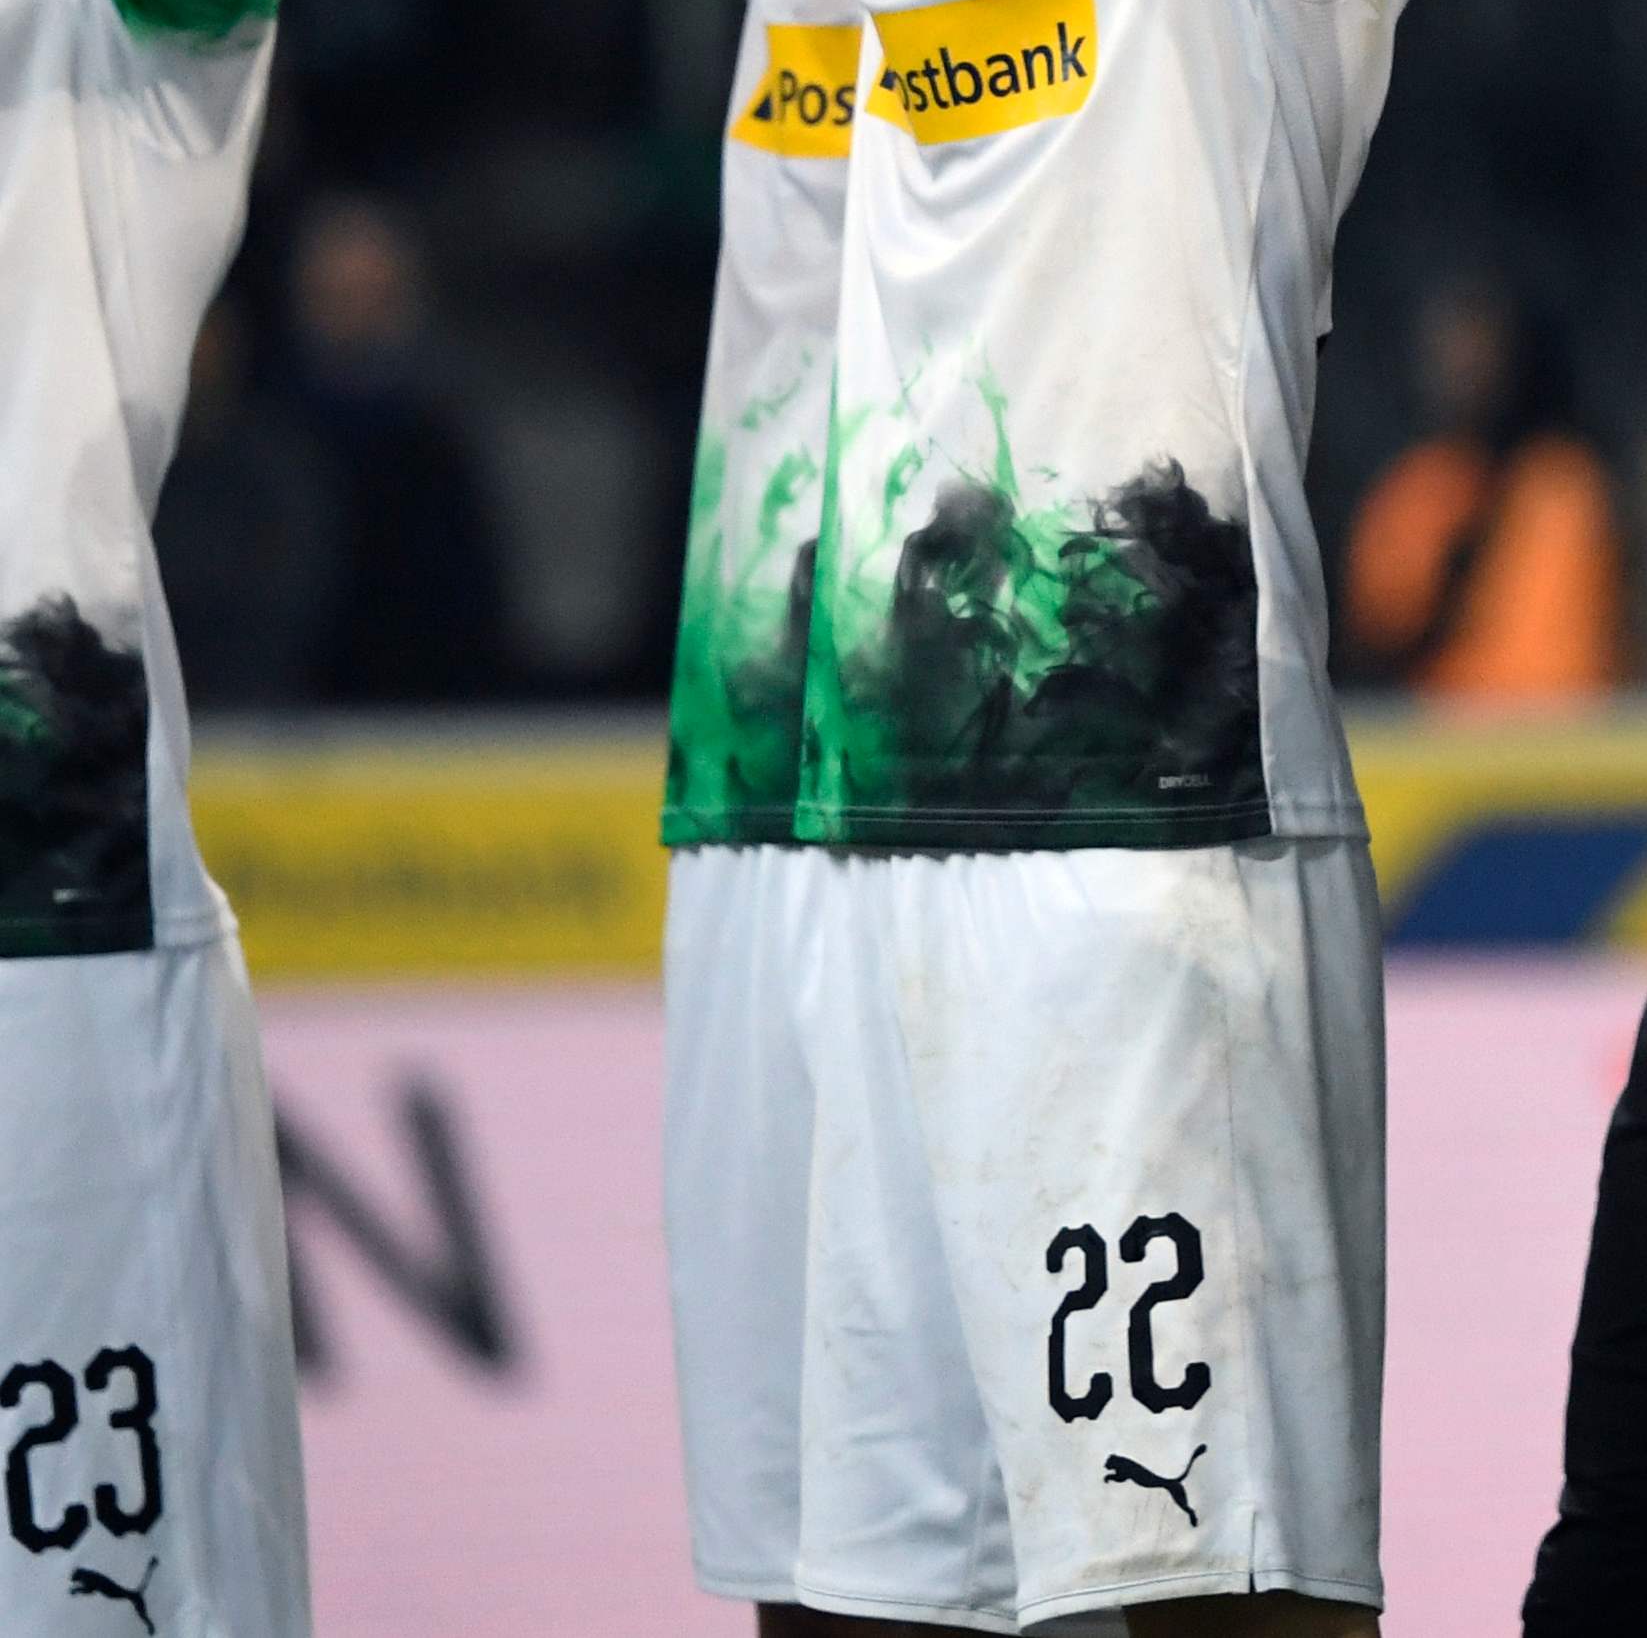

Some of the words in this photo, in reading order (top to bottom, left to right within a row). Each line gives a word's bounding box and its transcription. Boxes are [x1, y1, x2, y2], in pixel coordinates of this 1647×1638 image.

[896, 21, 1088, 113] ostbank
[1046, 1212, 1212, 1424] 22
[0, 1344, 163, 1554] 23
